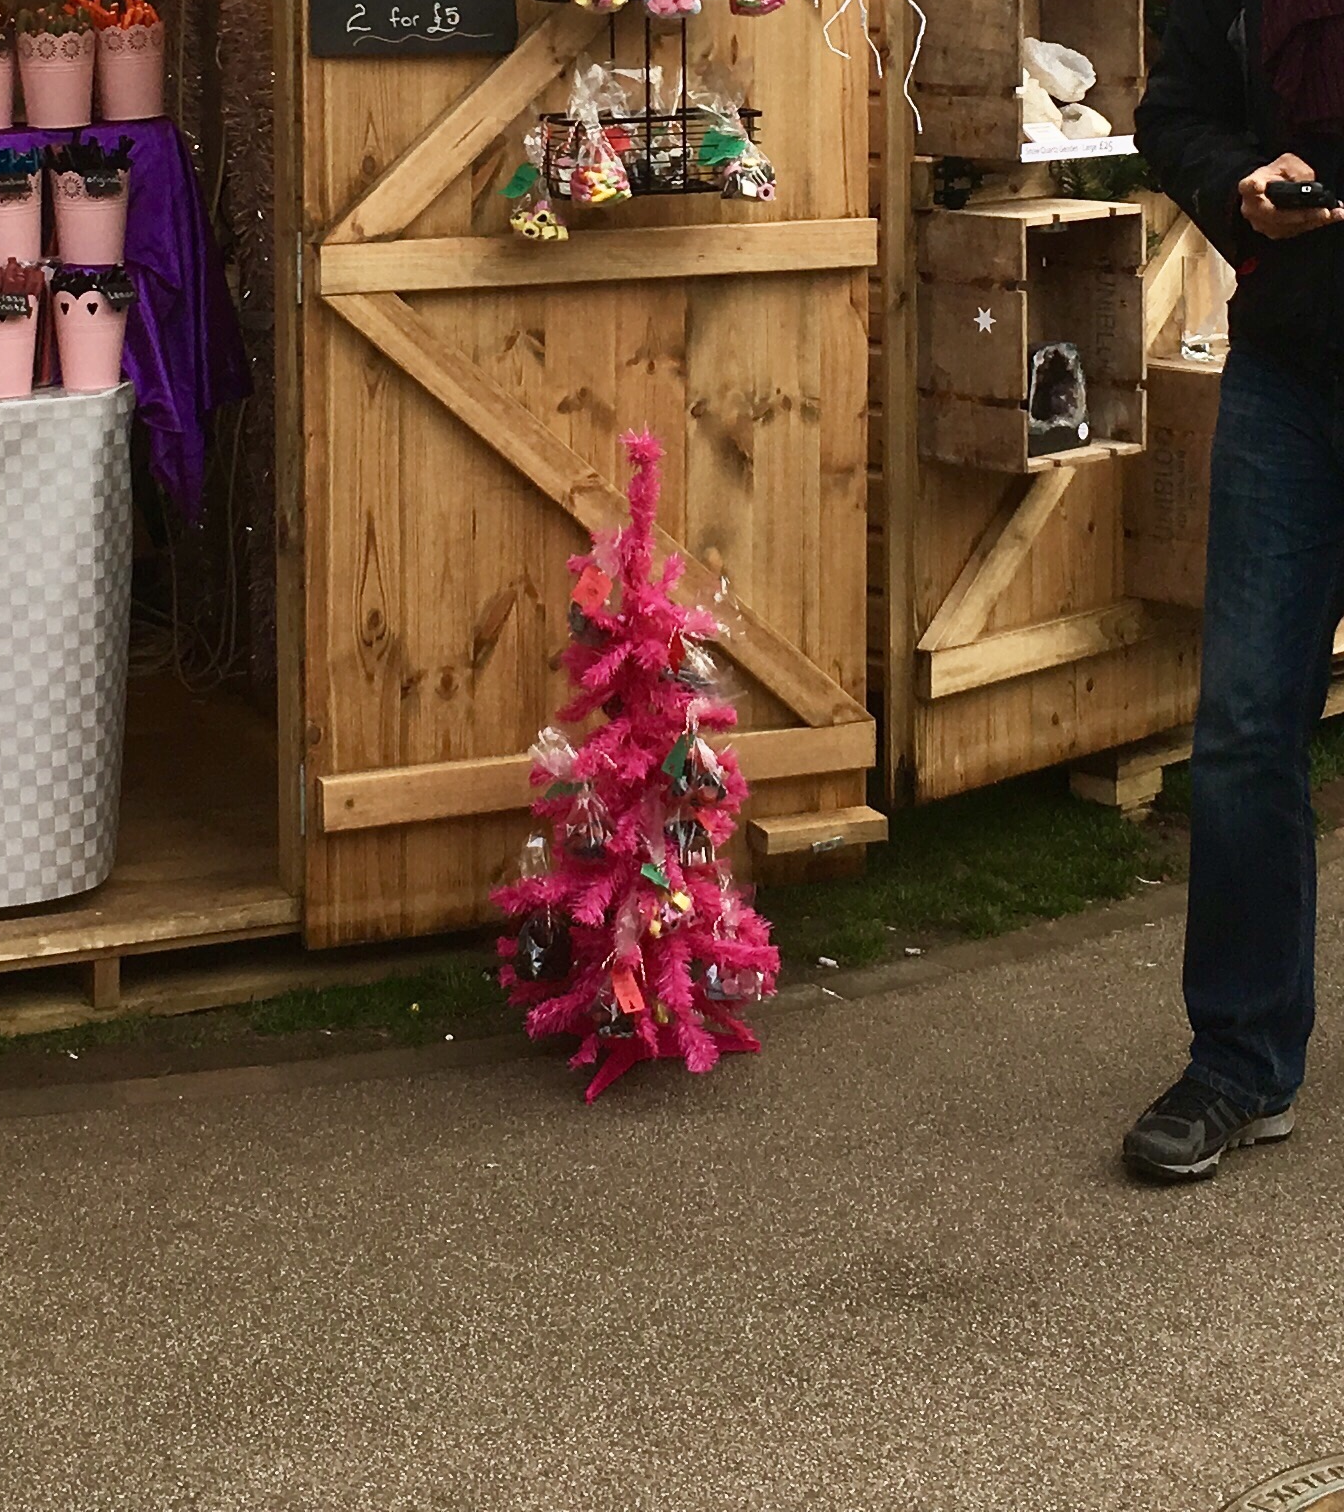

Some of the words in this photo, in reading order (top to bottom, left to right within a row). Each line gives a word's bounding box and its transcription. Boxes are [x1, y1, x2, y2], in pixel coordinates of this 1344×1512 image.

[347, 3, 372, 33] 2
[389, 7, 420, 28] for
[426, 3, 460, 34] £5
